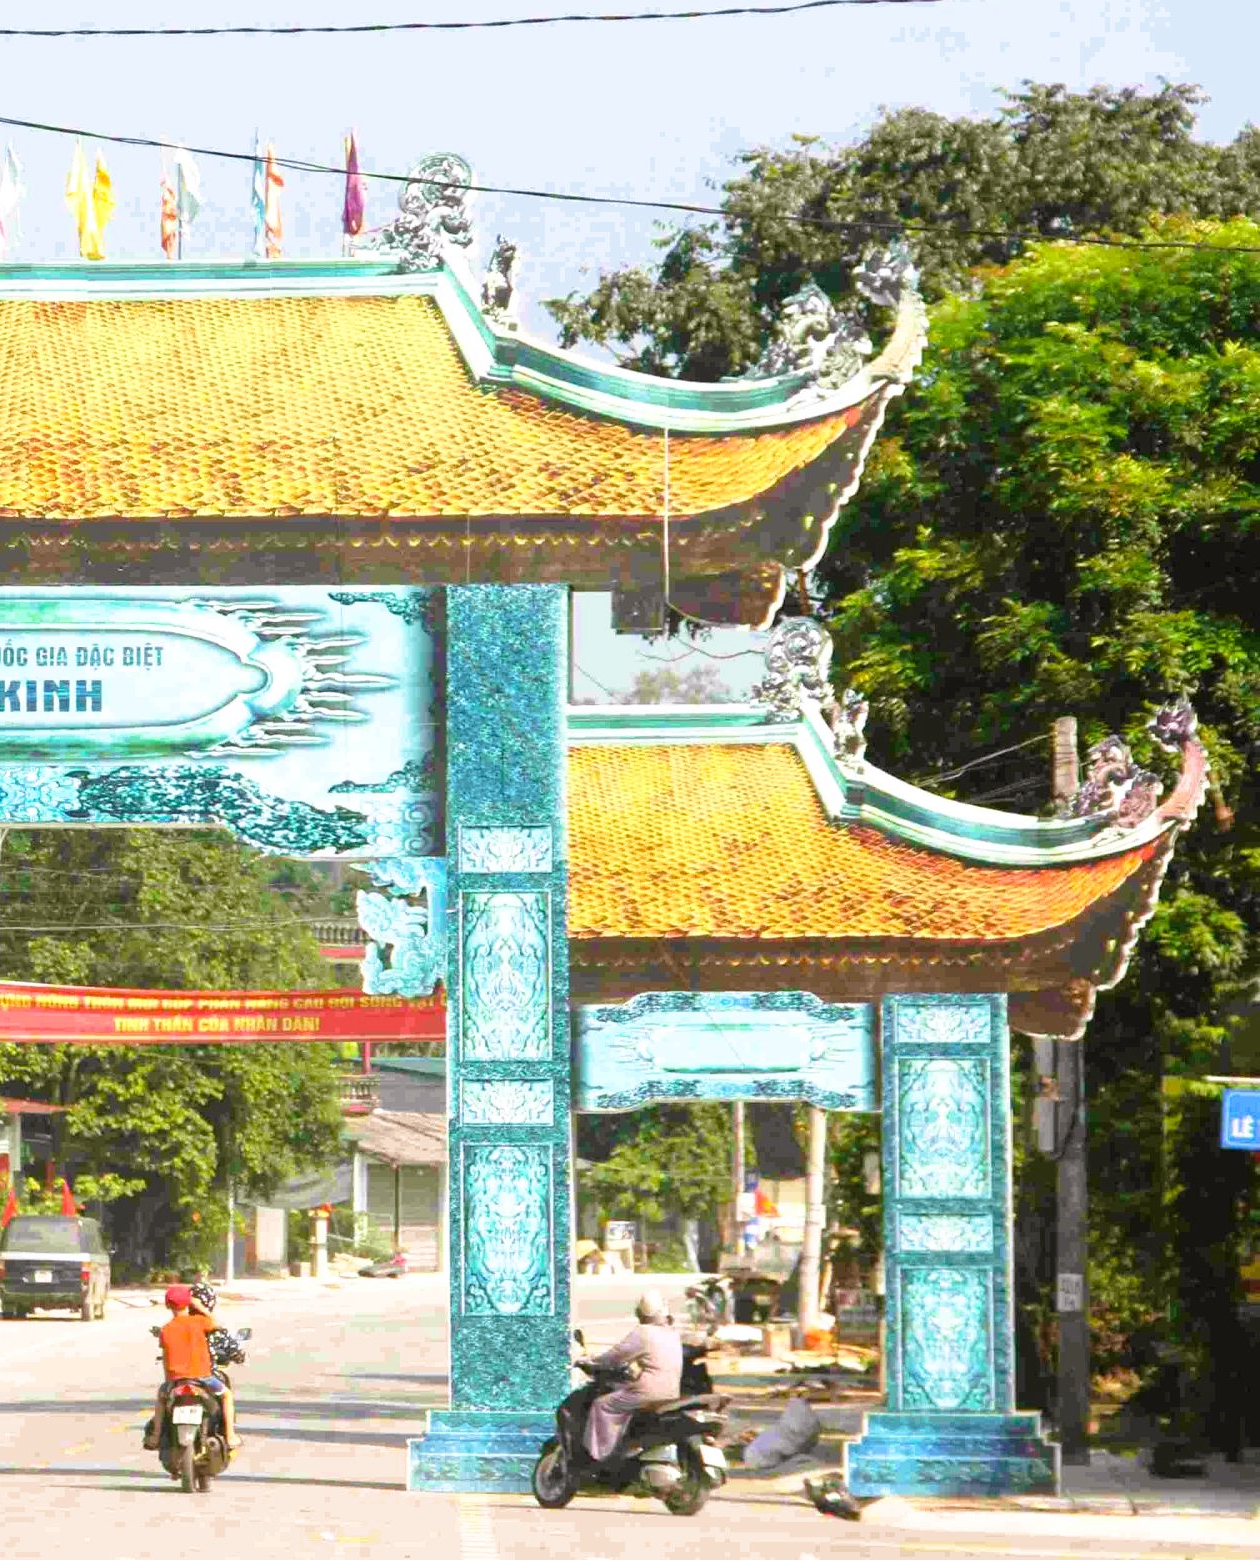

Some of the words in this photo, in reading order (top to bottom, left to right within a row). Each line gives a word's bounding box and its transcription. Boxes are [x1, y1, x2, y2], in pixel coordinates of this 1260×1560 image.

[36, 647, 68, 667] GIA
[76, 643, 114, 670] ĐẶC
[123, 643, 164, 670] BIỆT
[234, 1014, 278, 1032] NHÂN
